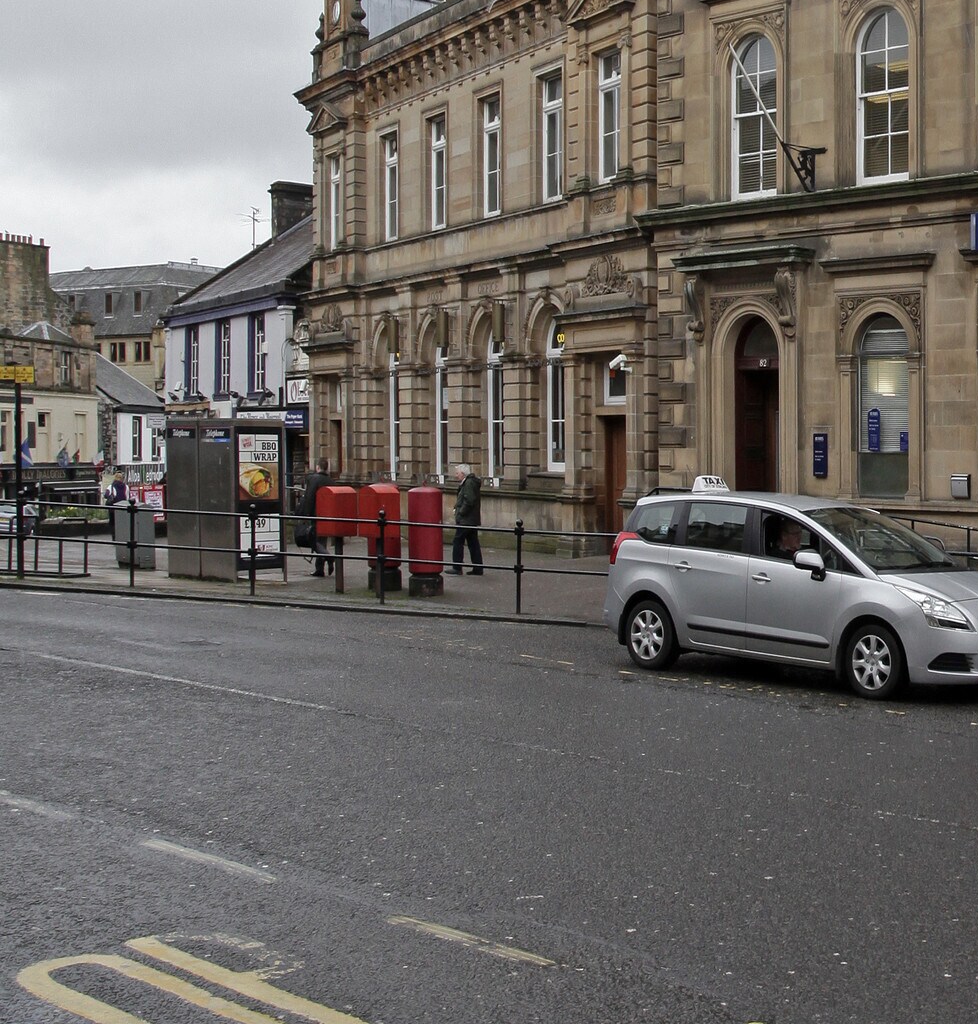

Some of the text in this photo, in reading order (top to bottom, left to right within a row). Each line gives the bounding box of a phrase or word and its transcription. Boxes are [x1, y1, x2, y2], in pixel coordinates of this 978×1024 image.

[426, 290, 443, 302] POST
[759, 358, 767, 367] 82
[172, 429, 190, 438] Telephone
[205, 429, 225, 438] Telephone
[253, 453, 277, 461] WRAP
[702, 477, 725, 485] TAXI
